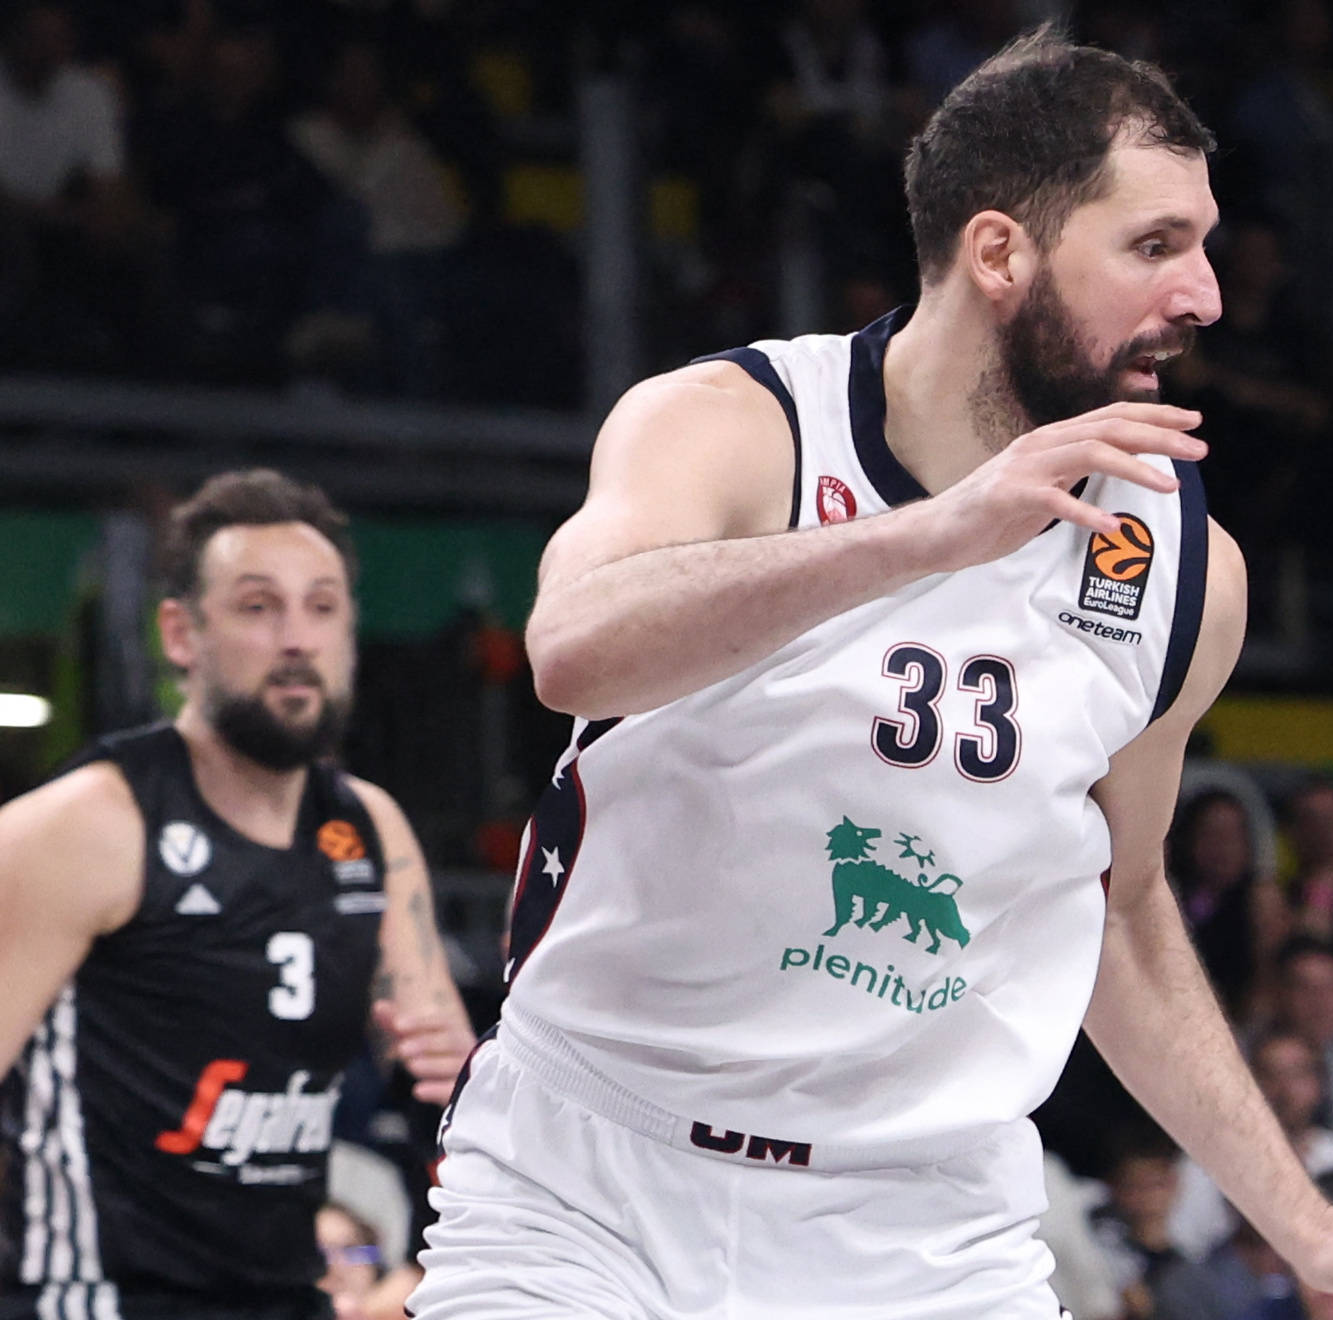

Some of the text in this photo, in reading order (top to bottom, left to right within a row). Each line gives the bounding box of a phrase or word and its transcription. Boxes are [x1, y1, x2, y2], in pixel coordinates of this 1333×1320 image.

[1083, 597, 1134, 616] EuroLeague
[1085, 587, 1137, 607] AIRLINES
[1088, 576, 1140, 597] TURKISH
[870, 642, 1022, 783] 33
[266, 931, 314, 1020] 3
[780, 944, 967, 1014] plenitude
